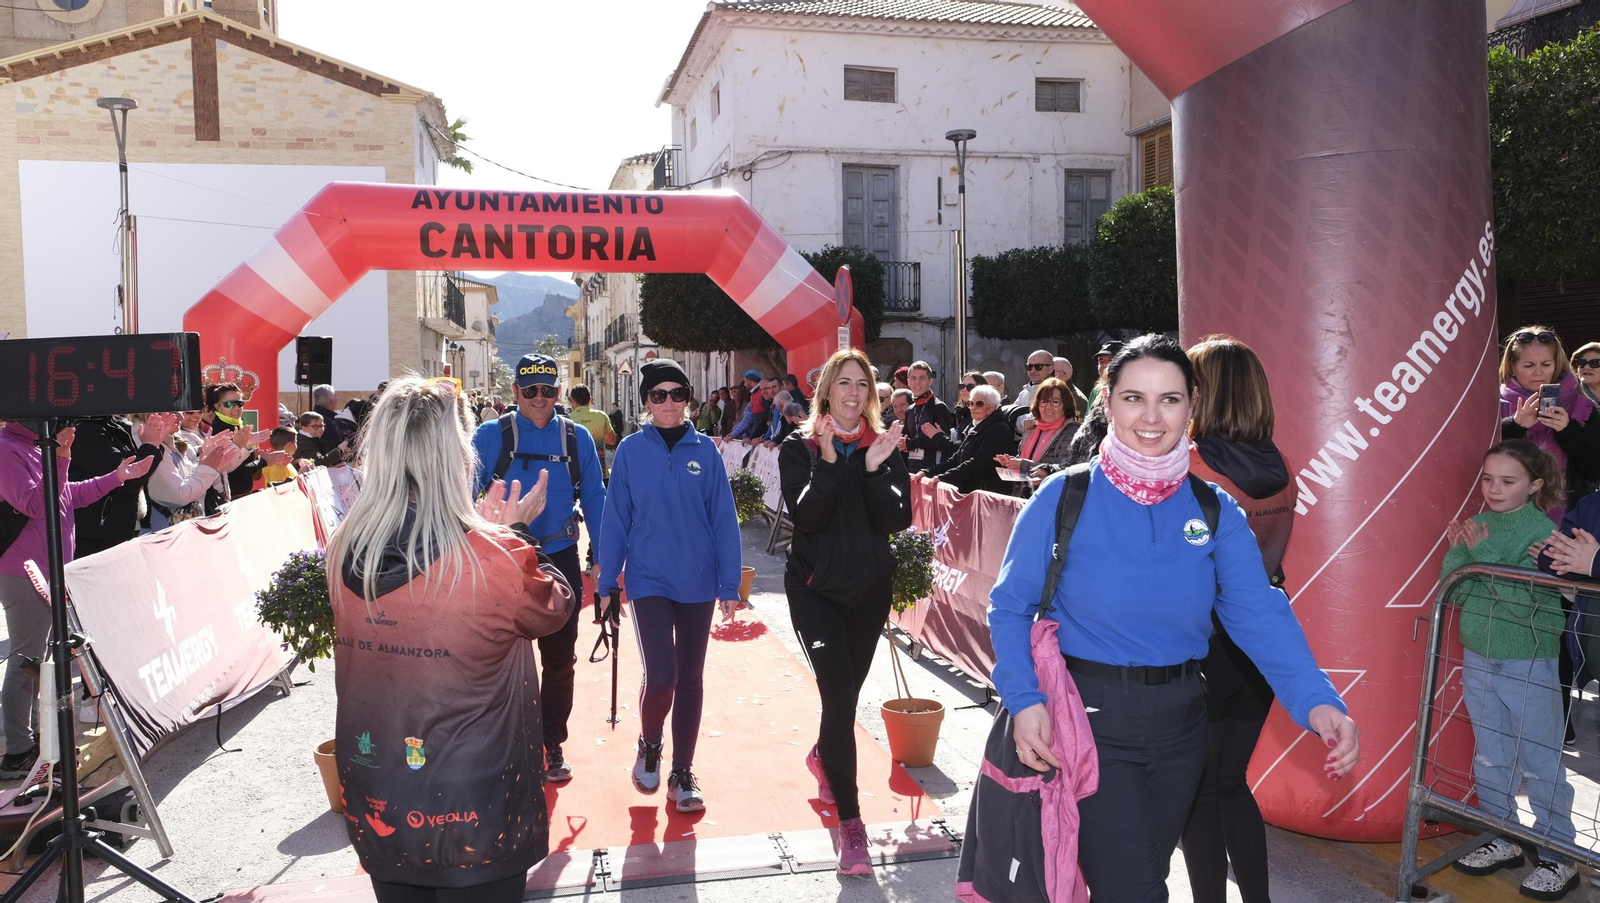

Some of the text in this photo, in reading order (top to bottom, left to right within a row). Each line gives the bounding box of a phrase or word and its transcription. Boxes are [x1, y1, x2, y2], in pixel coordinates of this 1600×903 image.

[411, 189, 664, 214] AYUNTAMIENTO
[419, 222, 656, 261] CANTORIA
[27, 341, 181, 407] 16:47
[519, 364, 557, 376] adidas
[336, 636, 451, 659] ALLE DE ALMANZORA
[138, 624, 220, 704] TEAMERGY
[427, 811, 479, 825] VEOLIA
